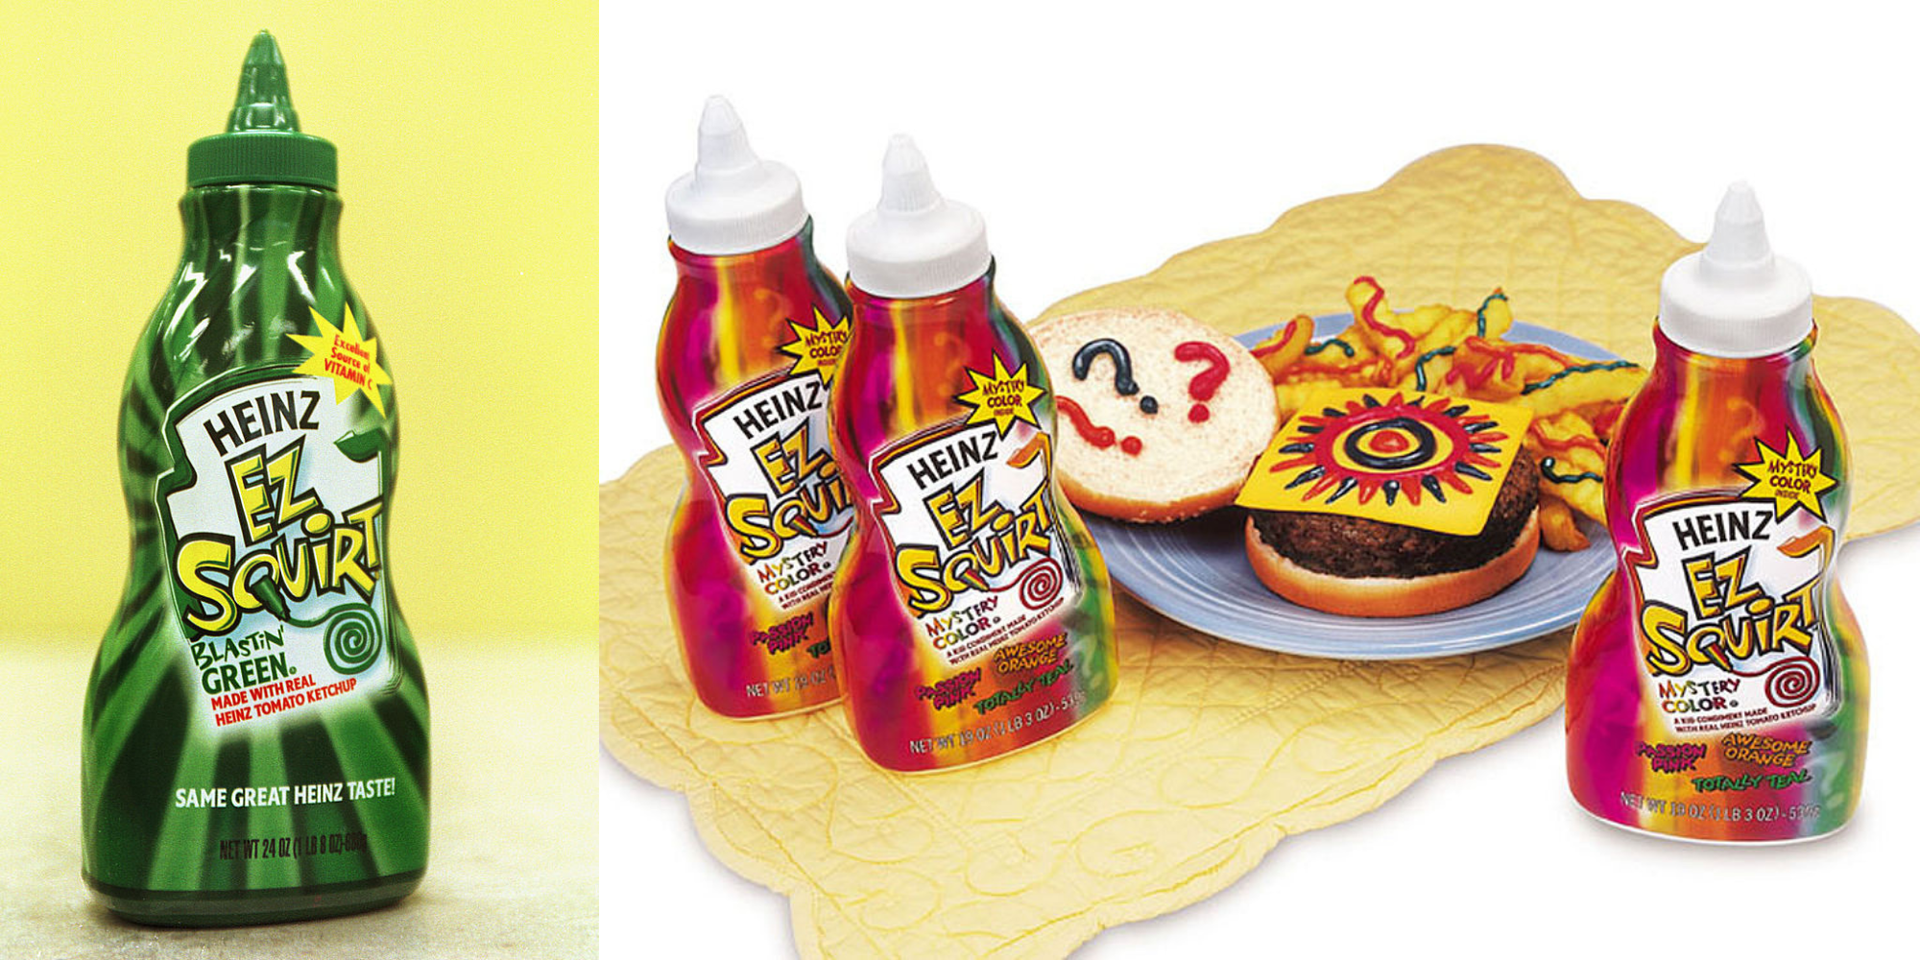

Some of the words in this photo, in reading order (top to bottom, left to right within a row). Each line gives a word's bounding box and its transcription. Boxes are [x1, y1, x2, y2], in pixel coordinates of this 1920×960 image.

[324, 357, 366, 387] VITAMIN
[367, 378, 373, 391] C
[330, 346, 361, 369] Source
[733, 381, 822, 439] HEINZ
[987, 393, 1022, 409] COLOR
[203, 390, 321, 457] HEINZ
[750, 417, 835, 499] EZ
[907, 431, 998, 490] HEINZ
[224, 434, 324, 548] EZ
[1769, 475, 1811, 494] COLOR
[922, 467, 1005, 551] EZ
[1672, 510, 1773, 551] HEINZ
[757, 541, 828, 584] MYSTERY
[764, 561, 822, 596] COLOR
[1681, 545, 1768, 621] EZ
[750, 611, 814, 646] PASSION
[925, 595, 998, 638] MYSTERY
[933, 616, 992, 650] COLOR
[767, 630, 809, 655] PINK
[993, 632, 1068, 665] AWESOME
[997, 650, 1059, 675] ORANGE
[211, 691, 249, 711] MADE
[249, 681, 285, 701] WITH
[286, 674, 316, 695] REAL
[745, 681, 769, 698] NET
[915, 667, 982, 701] PASSION
[933, 680, 977, 711] PINK
[973, 679, 1035, 716] TOTALLY
[1035, 658, 1074, 687] TEAL
[1658, 678, 1740, 699] MYSTERY
[215, 706, 253, 727] HEINZ
[254, 694, 305, 717] TOMATO
[306, 677, 357, 704] KETCHUP
[1661, 697, 1727, 713] COLOR
[1697, 712, 1744, 724] CONDIMENT
[1744, 707, 1769, 719] MADE
[909, 739, 933, 754] NET
[934, 735, 955, 749] WT
[959, 728, 974, 746] 19
[975, 726, 992, 742] OZ
[1007, 717, 1023, 735] LB
[1025, 712, 1032, 726] 3
[1675, 725, 1698, 733] WITH
[1698, 723, 1719, 732] REAL
[1745, 714, 1780, 727] TOMATO
[1634, 741, 1707, 759] PASSION
[1721, 731, 1812, 756] AWESOME
[1723, 747, 1796, 768] ORANGE
[1651, 755, 1697, 773] PINK
[1692, 774, 1763, 793] TOTALLY
[1765, 768, 1812, 789] TEAL
[175, 788, 227, 808] SAME
[231, 786, 290, 807] GREAT
[294, 782, 343, 805] HEINZ
[346, 777, 396, 800] TASTE!
[1621, 791, 1644, 809] NET
[1647, 797, 1667, 813] WT
[1689, 804, 1706, 820] OZ
[1723, 808, 1740, 822] LB
[1744, 809, 1751, 822] 3
[1756, 806, 1779, 823] OZ)
[220, 839, 241, 860] NET
[243, 839, 260, 860] WT
[262, 838, 276, 859] 24
[279, 837, 291, 858] OZ
[305, 835, 317, 856] LB
